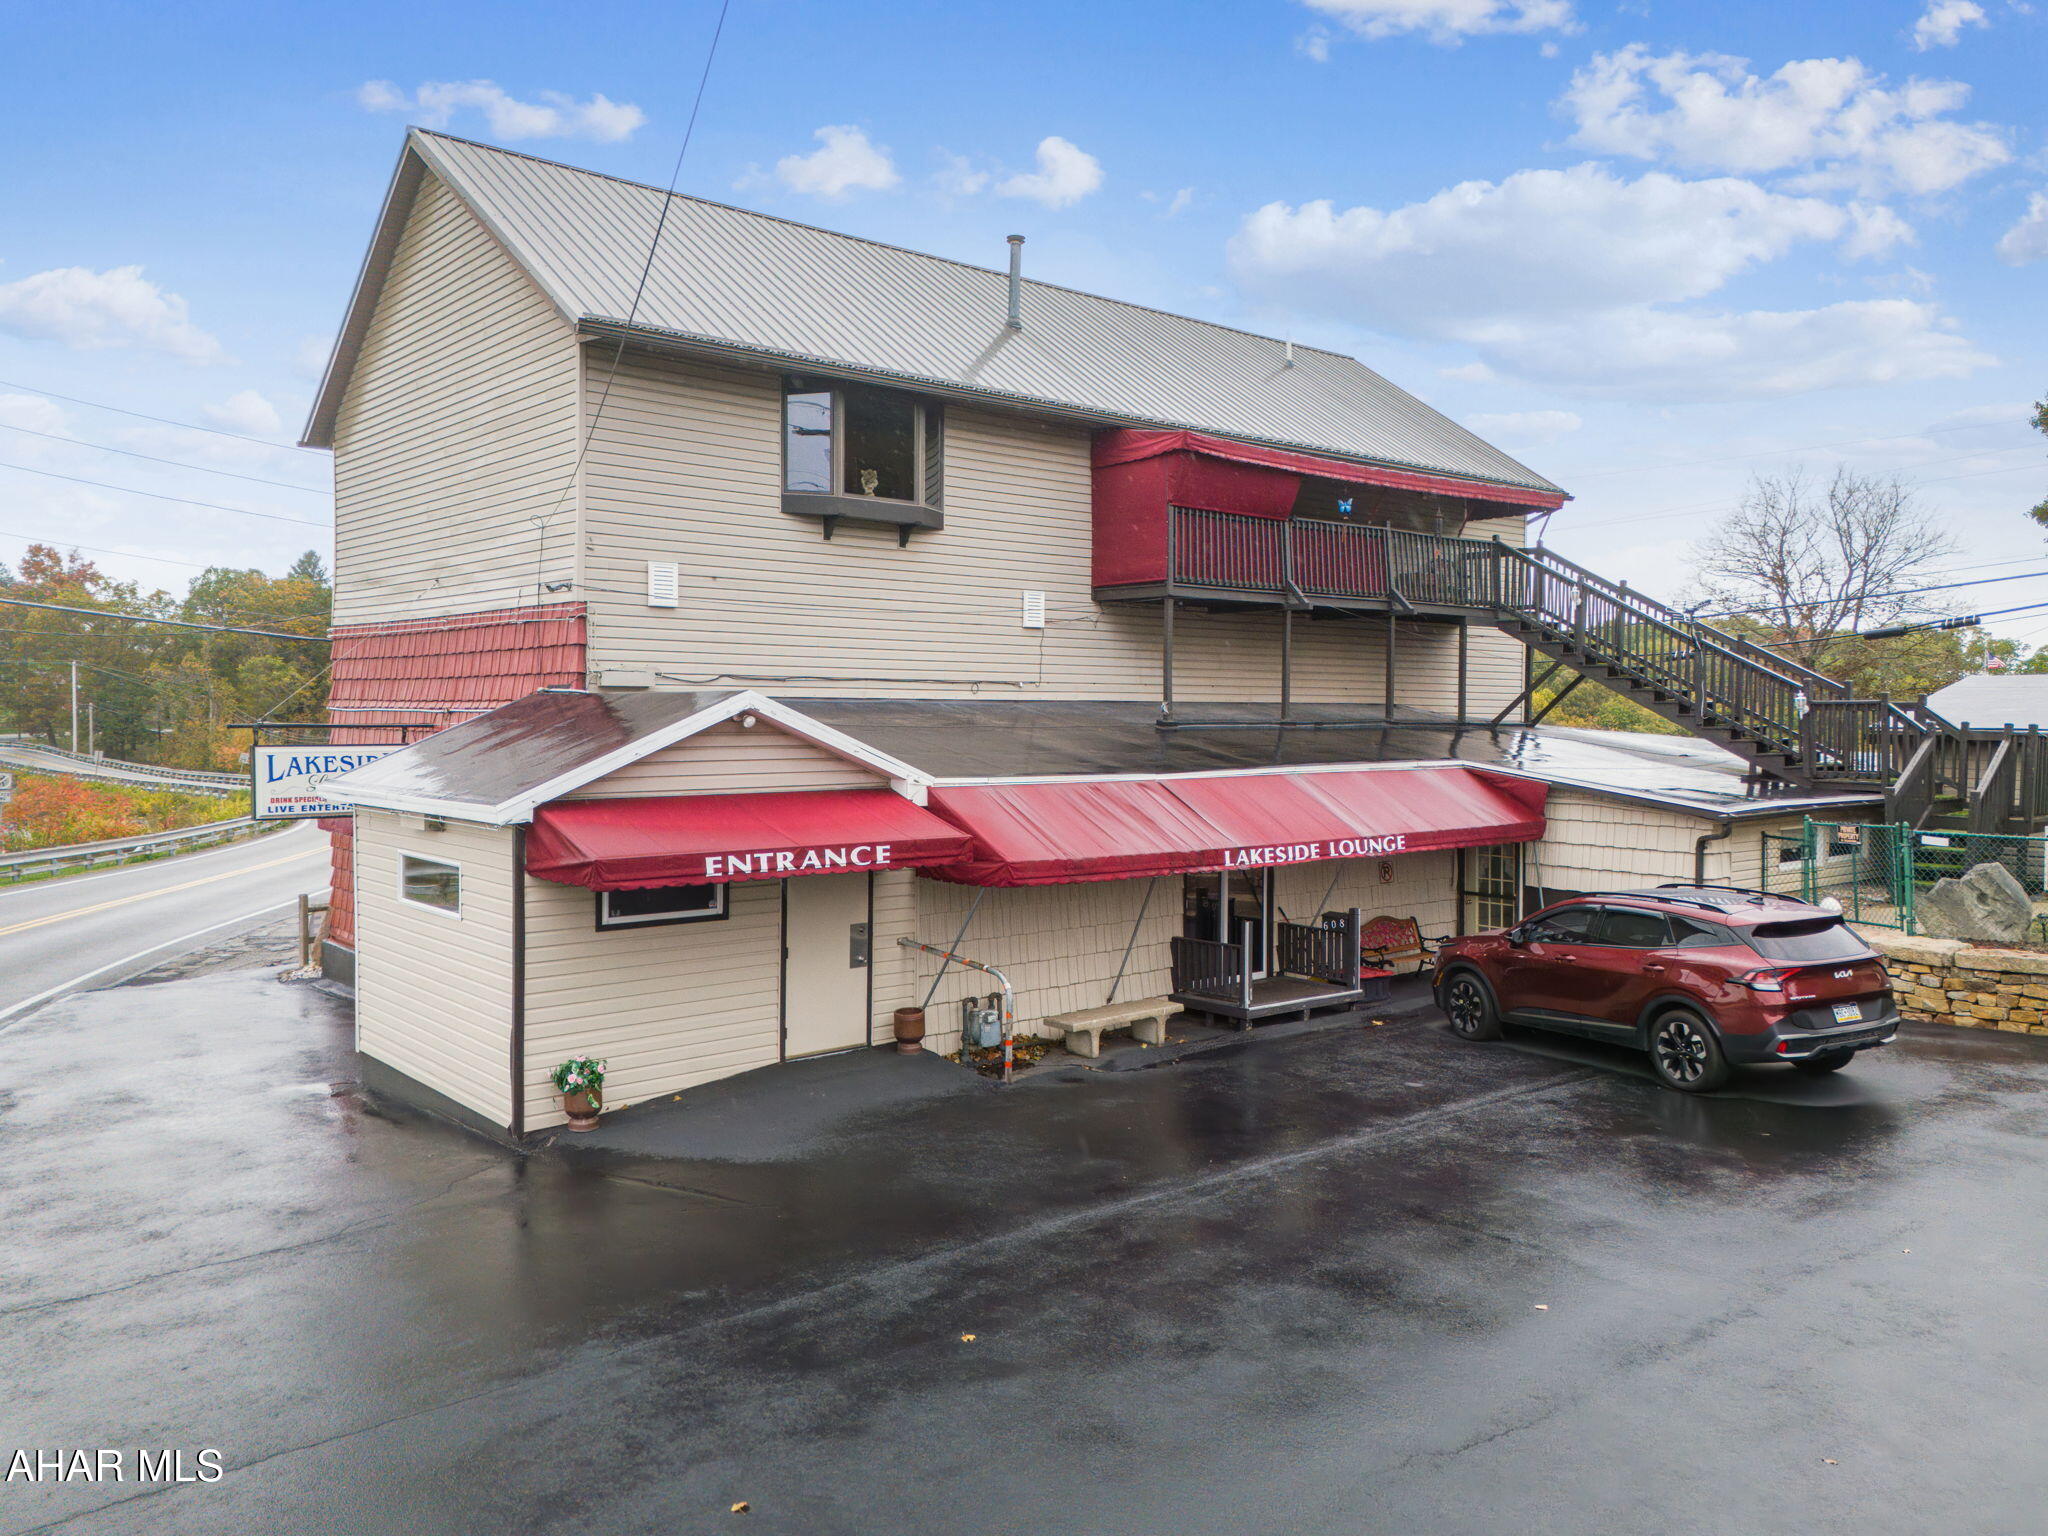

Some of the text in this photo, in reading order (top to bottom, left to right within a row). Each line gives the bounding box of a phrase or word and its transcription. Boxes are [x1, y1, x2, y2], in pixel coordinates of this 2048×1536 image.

[266, 752, 388, 783] LAKESI
[270, 796, 293, 804] DRINK
[268, 805, 295, 813] LIVE
[1224, 835, 1406, 867] LAKESIDE LOUNGE
[705, 845, 891, 877] ENTRANCE
[1323, 918, 1345, 930] 608
[1834, 969, 1853, 979] KIA
